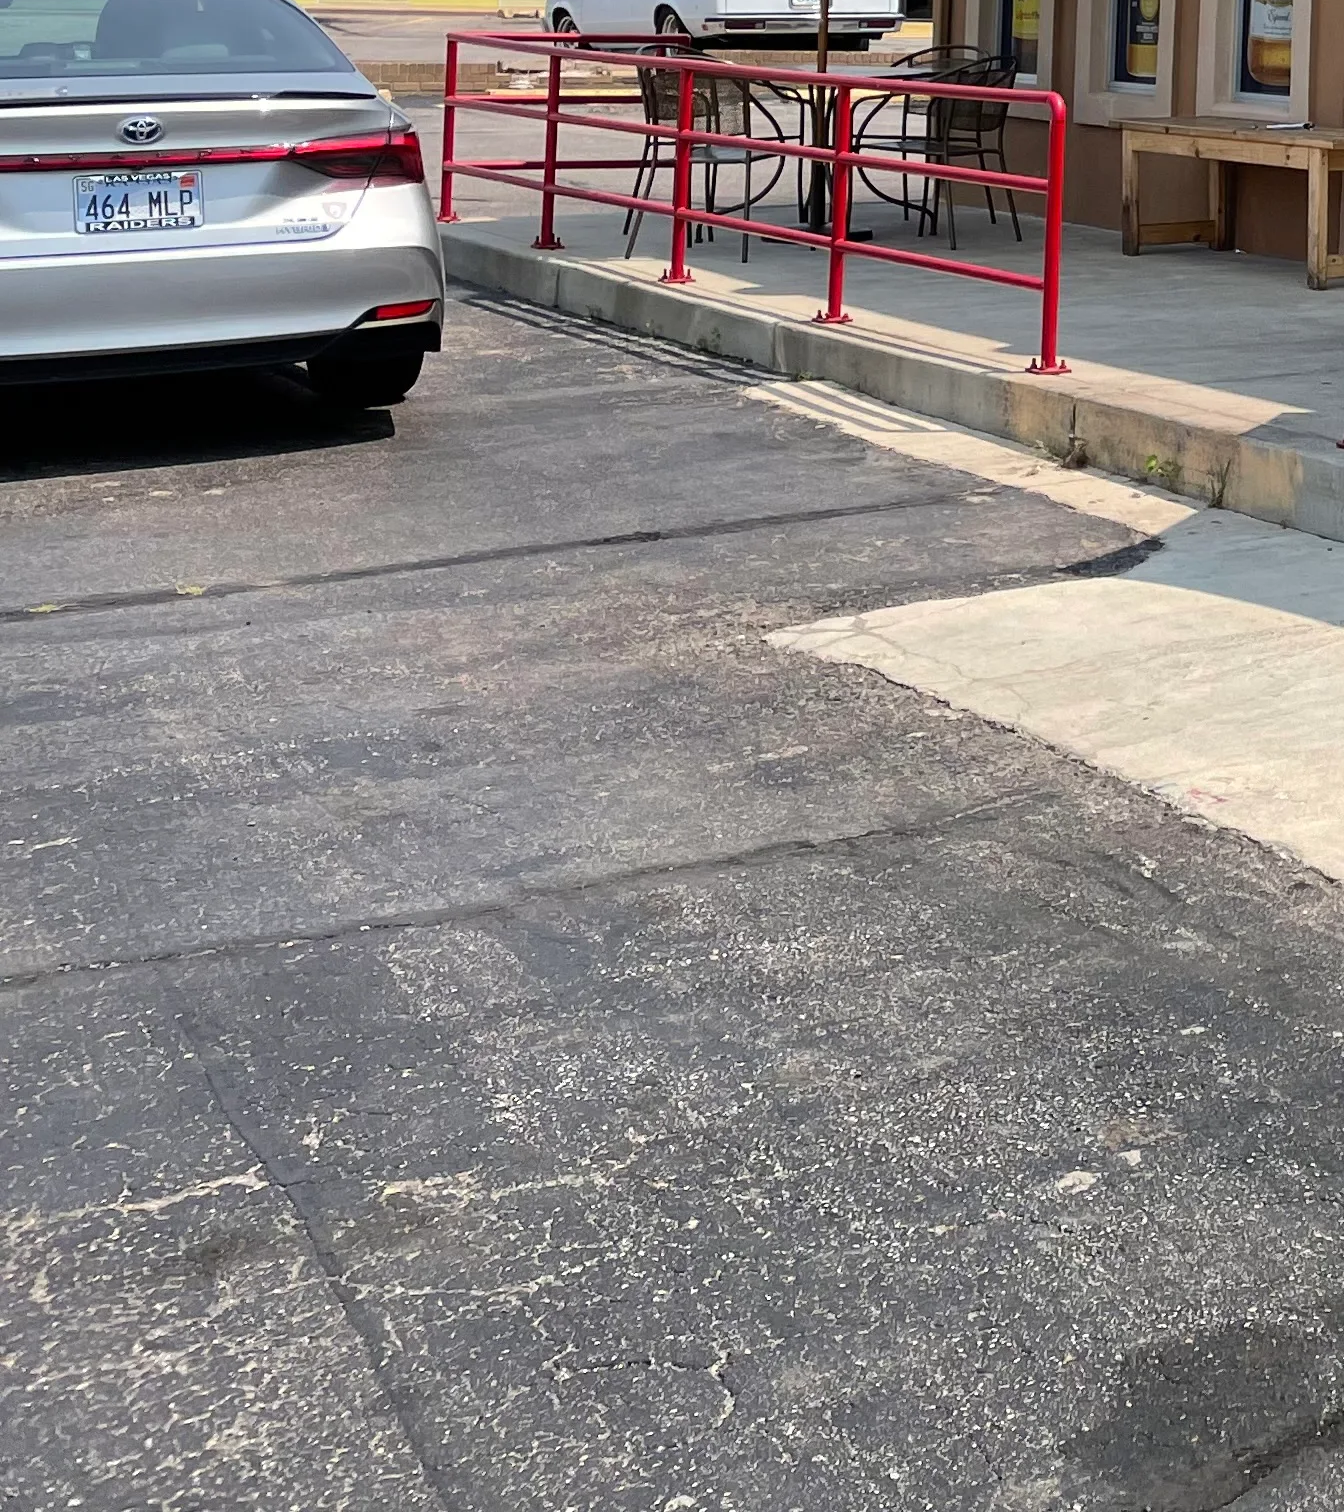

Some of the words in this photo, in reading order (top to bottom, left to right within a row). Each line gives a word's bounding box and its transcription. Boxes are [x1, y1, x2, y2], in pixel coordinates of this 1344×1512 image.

[105, 175, 128, 183] LAS
[131, 173, 171, 182] VEGAS
[85, 193, 130, 220] 464
[148, 189, 193, 218] MLP
[89, 217, 192, 231] RAIDERS
